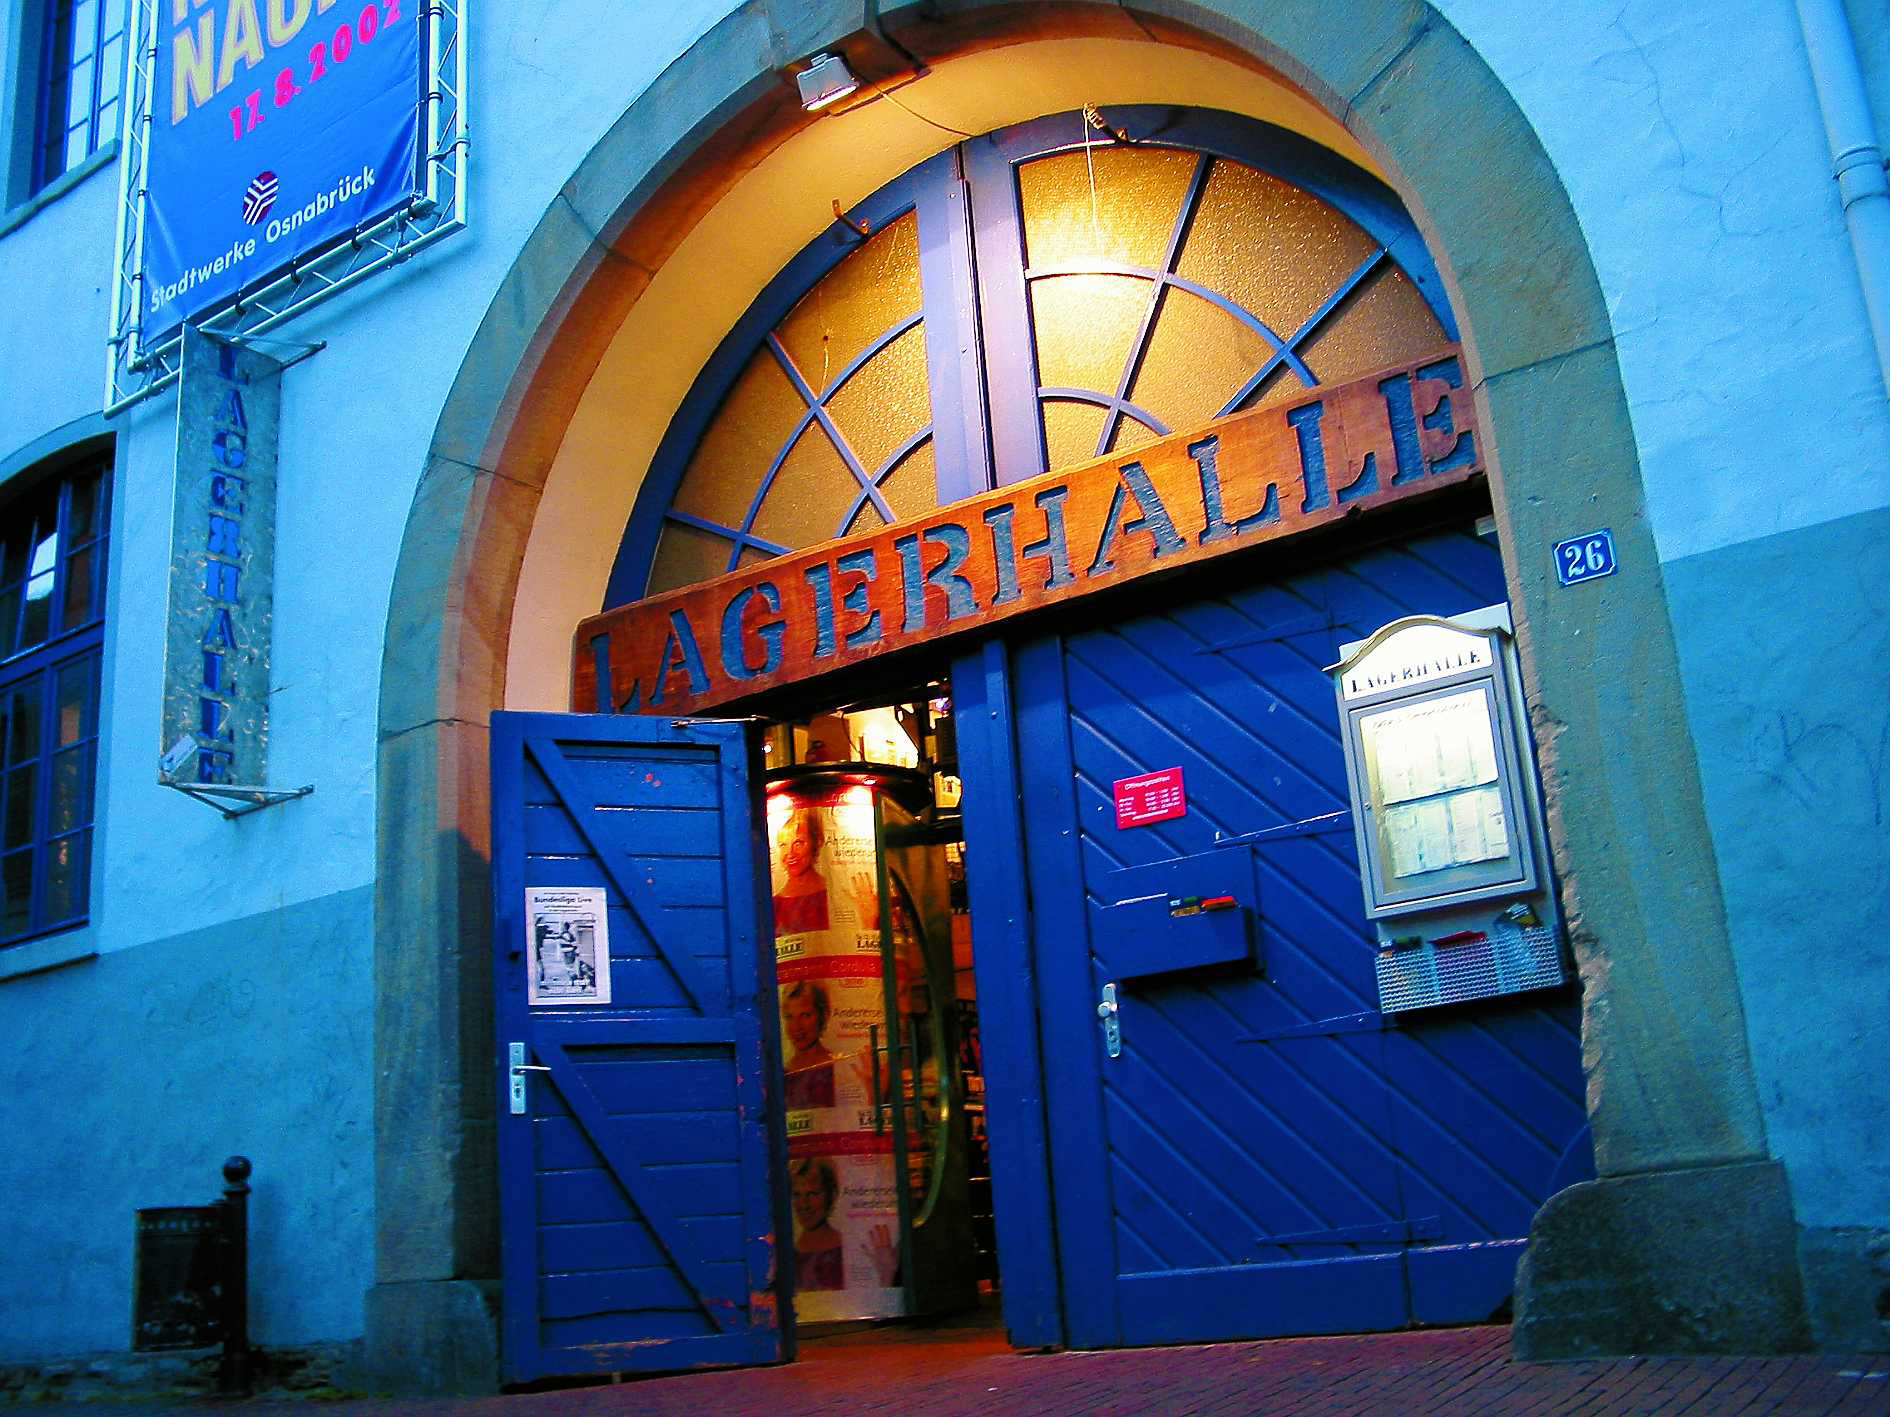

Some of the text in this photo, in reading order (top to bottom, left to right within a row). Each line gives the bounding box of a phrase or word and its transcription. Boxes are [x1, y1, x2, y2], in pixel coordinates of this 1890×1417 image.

[151, 166, 376, 312] Stadtwerke Osnabrück
[199, 343, 249, 785] LAGERHALLE
[590, 354, 1477, 714] LAGERHALLE
[1565, 540, 1604, 578] 26
